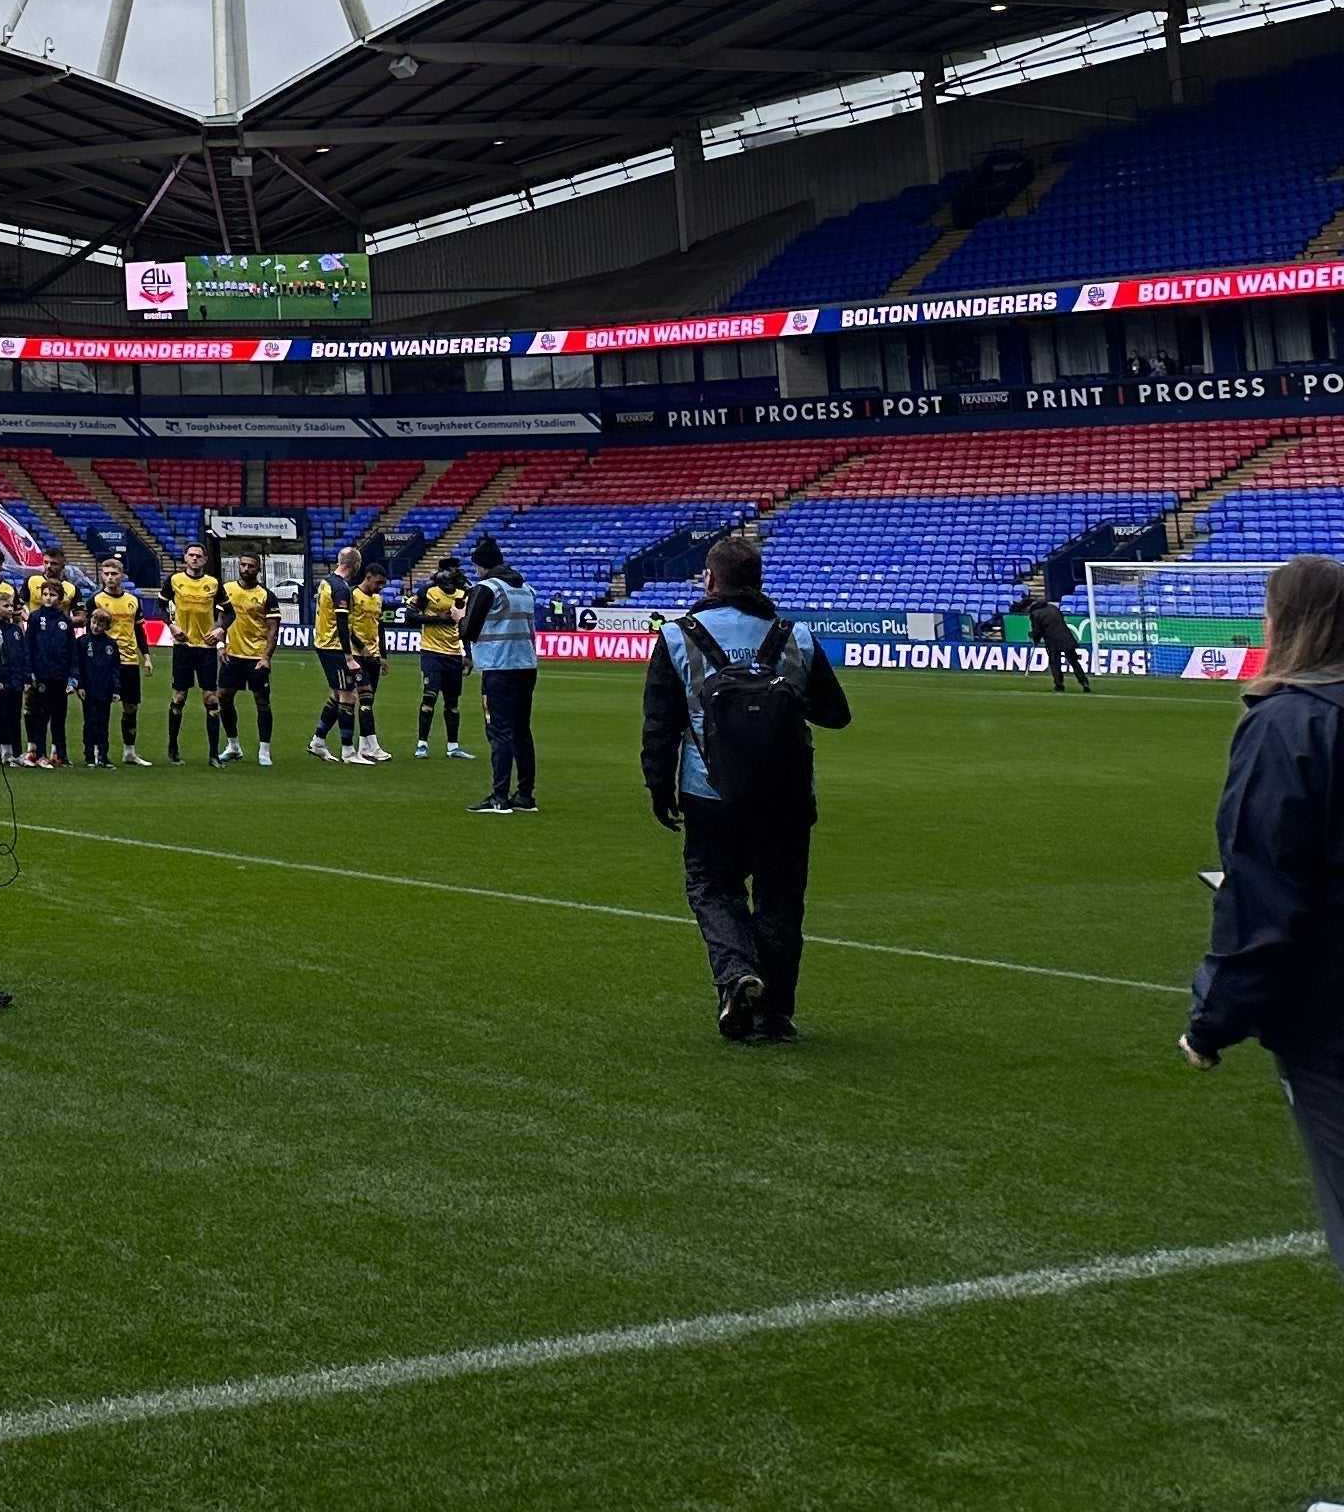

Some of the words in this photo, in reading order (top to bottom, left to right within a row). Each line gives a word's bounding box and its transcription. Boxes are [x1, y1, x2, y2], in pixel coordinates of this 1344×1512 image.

[1138, 276, 1231, 303] BOLTON
[1236, 266, 1344, 295] WANDER
[841, 303, 919, 328] BOLTON
[922, 291, 1058, 321] WANDERERS
[586, 327, 650, 350] BOLTON
[652, 318, 765, 345] WANDERERS
[40, 341, 109, 358] BOLTON
[113, 342, 233, 359] WANDERERS
[311, 341, 387, 359] BOLTON
[390, 336, 511, 356] WANDERERS
[1027, 387, 1104, 409] PRINT
[1139, 377, 1265, 403] PROCESS
[668, 408, 728, 428] PRINT
[756, 400, 853, 423] PROCESS
[884, 395, 942, 417] POST
[24, 418, 77, 431] Community
[80, 419, 117, 430] Stadium
[186, 422, 242, 433] Toughsheet
[244, 422, 301, 434] Community
[304, 421, 346, 432] Stadium
[417, 421, 472, 432] Toughsheet
[475, 419, 532, 431] Community
[534, 417, 576, 429] Stadium
[238, 520, 288, 531] Toughsheet
[882, 619, 908, 636] Plu
